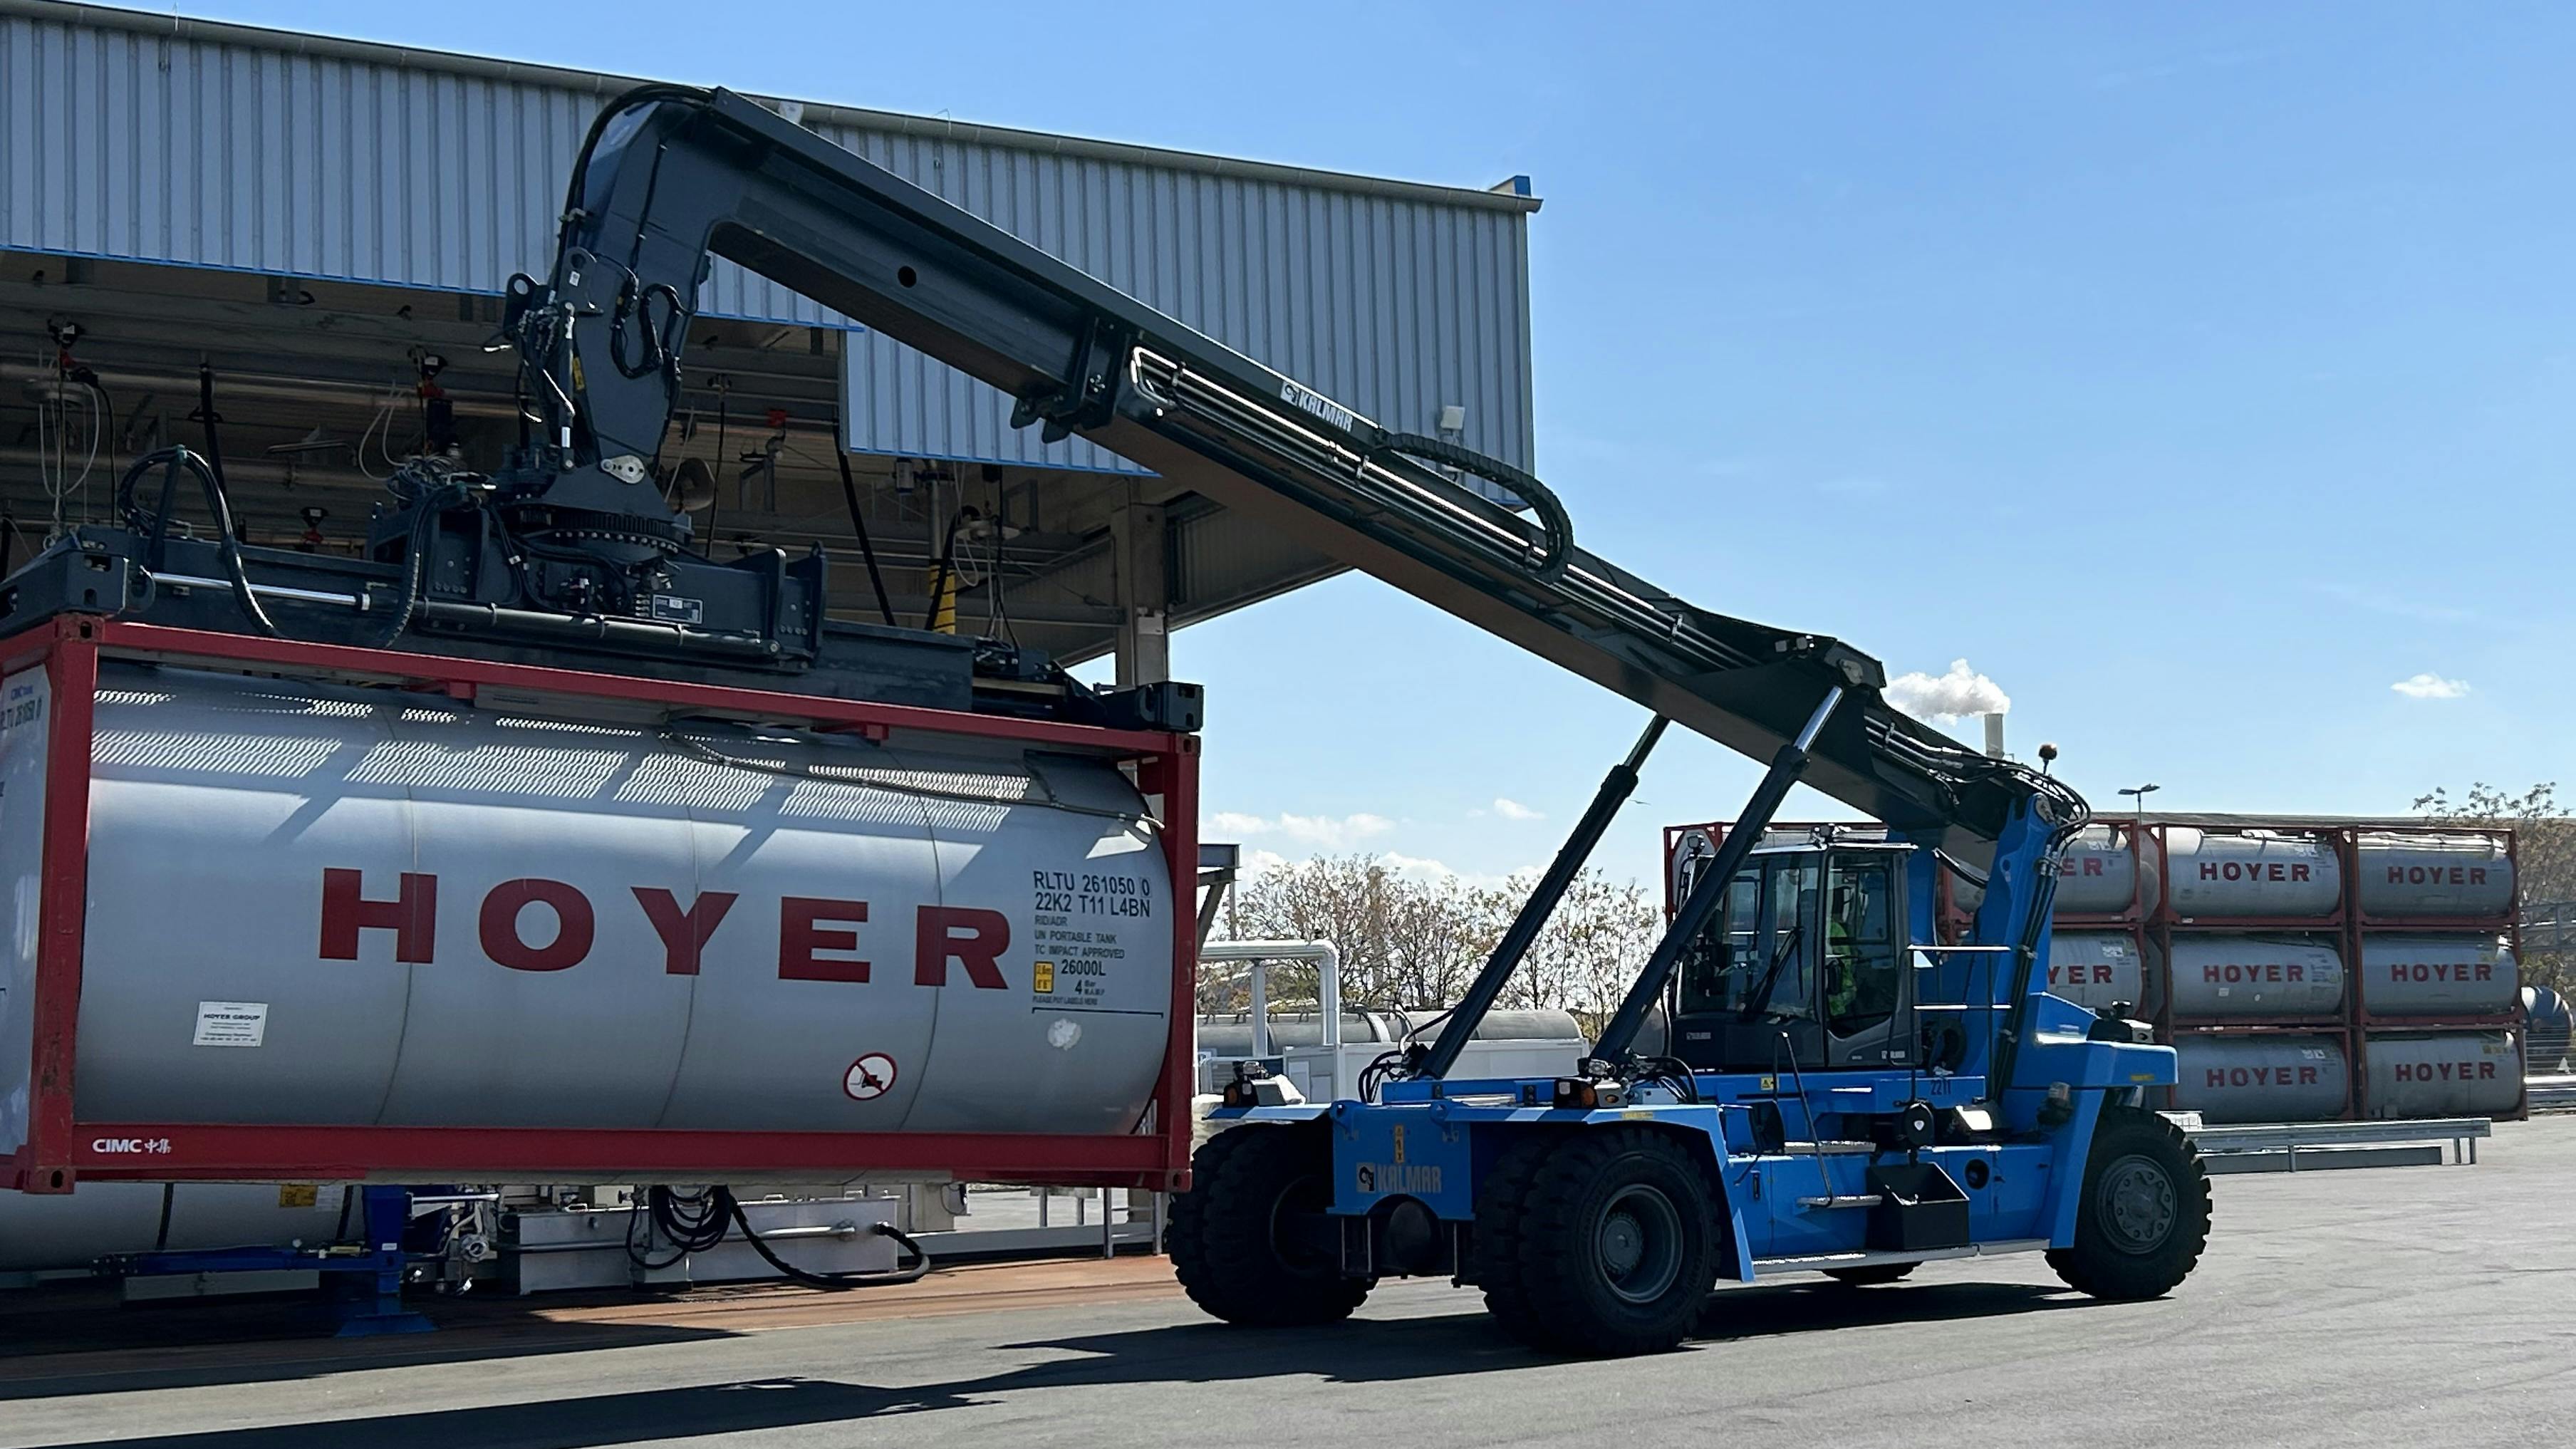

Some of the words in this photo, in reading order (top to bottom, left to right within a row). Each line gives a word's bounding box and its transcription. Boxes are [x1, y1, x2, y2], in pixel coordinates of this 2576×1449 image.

[1299, 390, 1354, 432] KALMAR
[2200, 862, 2310, 882] HOYER
[2387, 866, 2487, 885] HOYER
[1034, 871, 1075, 890] RLTU
[1082, 875, 1135, 895] 261050
[1142, 879, 1150, 896] 0
[1035, 892, 1072, 912] 22K2
[1079, 895, 1104, 914] T11
[1111, 897, 1150, 918] L4BN
[318, 868, 1010, 990] HOYER
[1034, 930, 1046, 940] UN
[1050, 930, 1091, 942] PORTABLE
[1096, 933, 1117, 944] TANK
[1034, 944, 1045, 955] TC
[1049, 945, 1079, 956] IMPACT
[1081, 947, 1125, 959] APPROVED
[1061, 959, 1106, 976] 26000L
[2048, 965, 2113, 985] YER
[2203, 965, 2304, 983] HOYER
[2391, 963, 2492, 982] HOYER
[1075, 980, 1082, 994] 4
[2206, 1066, 2318, 1089] HOYER
[2396, 1061, 2496, 1082] HOYER
[1931, 1080, 1951, 1096] 2211
[93, 1139, 142, 1153] CIMC
[1377, 1164, 1442, 1193] KALMAR
